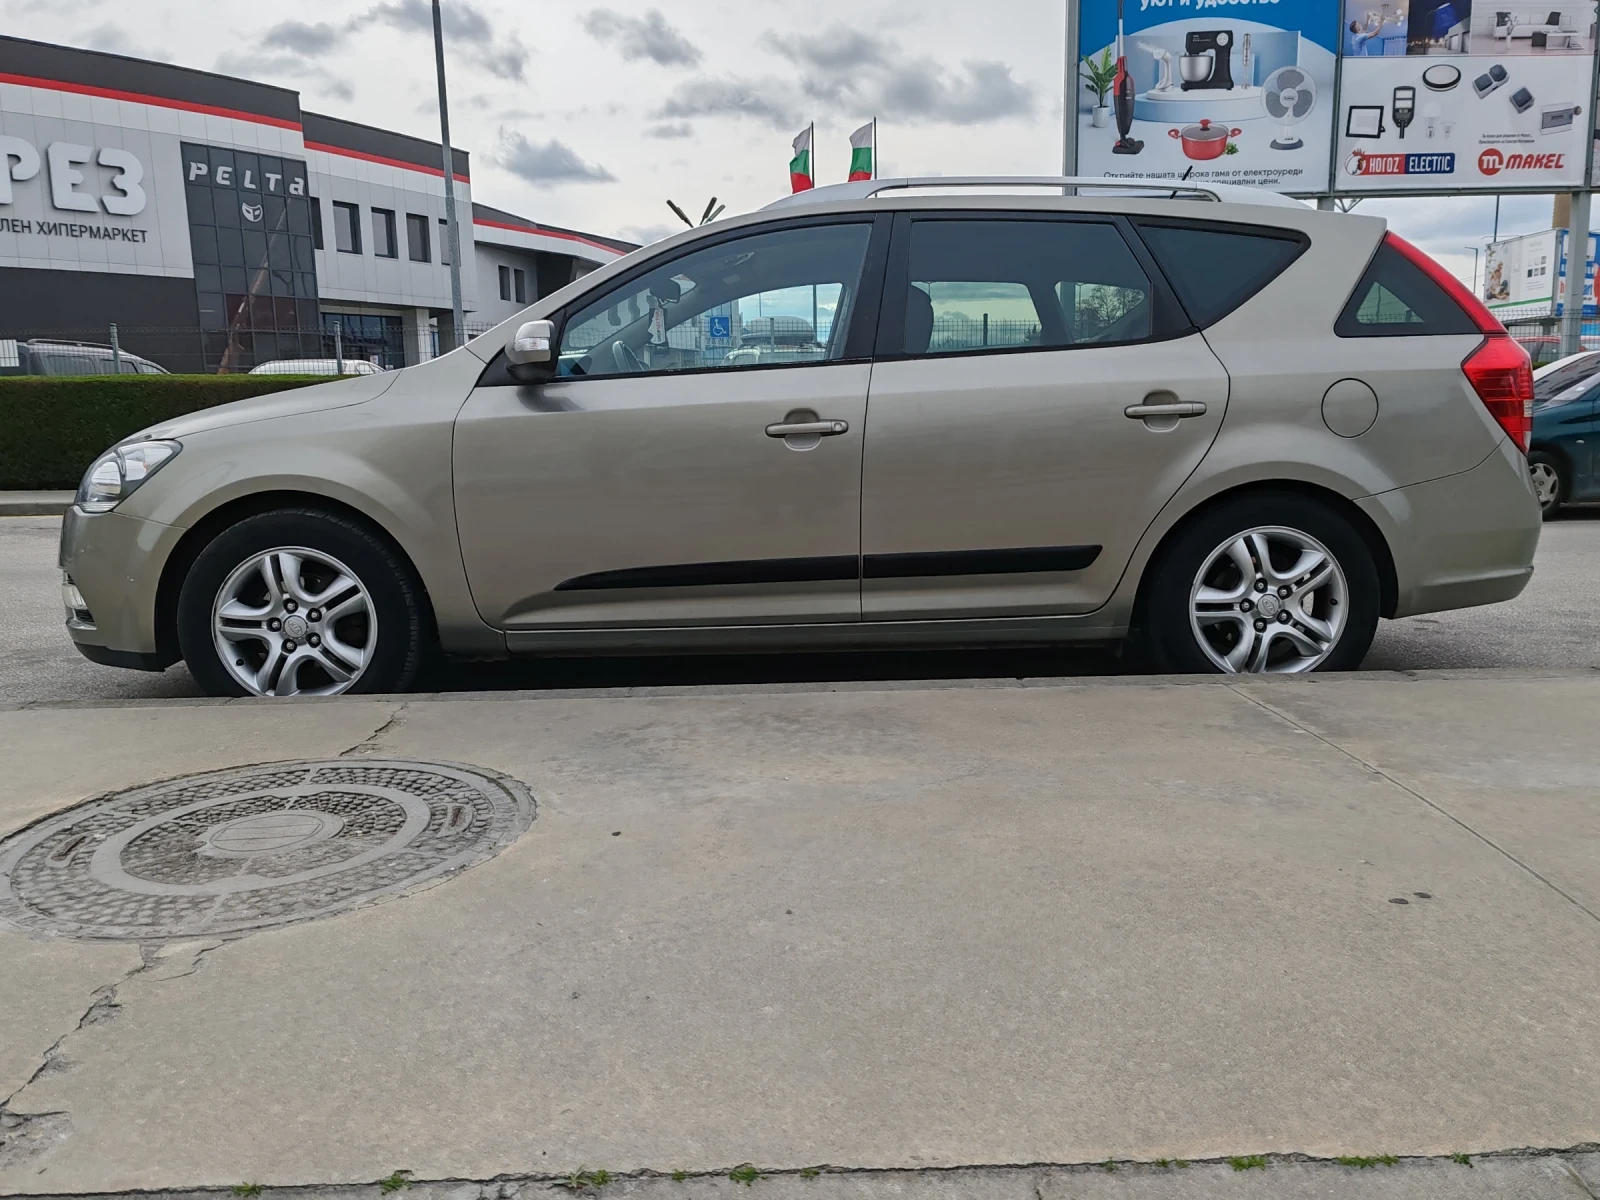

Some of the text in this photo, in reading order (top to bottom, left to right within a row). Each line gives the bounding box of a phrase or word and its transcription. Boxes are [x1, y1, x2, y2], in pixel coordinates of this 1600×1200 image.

[1409, 156, 1451, 172] ELECTRIC
[1505, 153, 1565, 169] MAKEL
[1231, 169, 1242, 177] от
[1243, 168, 1303, 177] електроуреди
[1257, 178, 1281, 186] цени.
[35, 220, 148, 243] ХИПЕРМАРКЕТ
